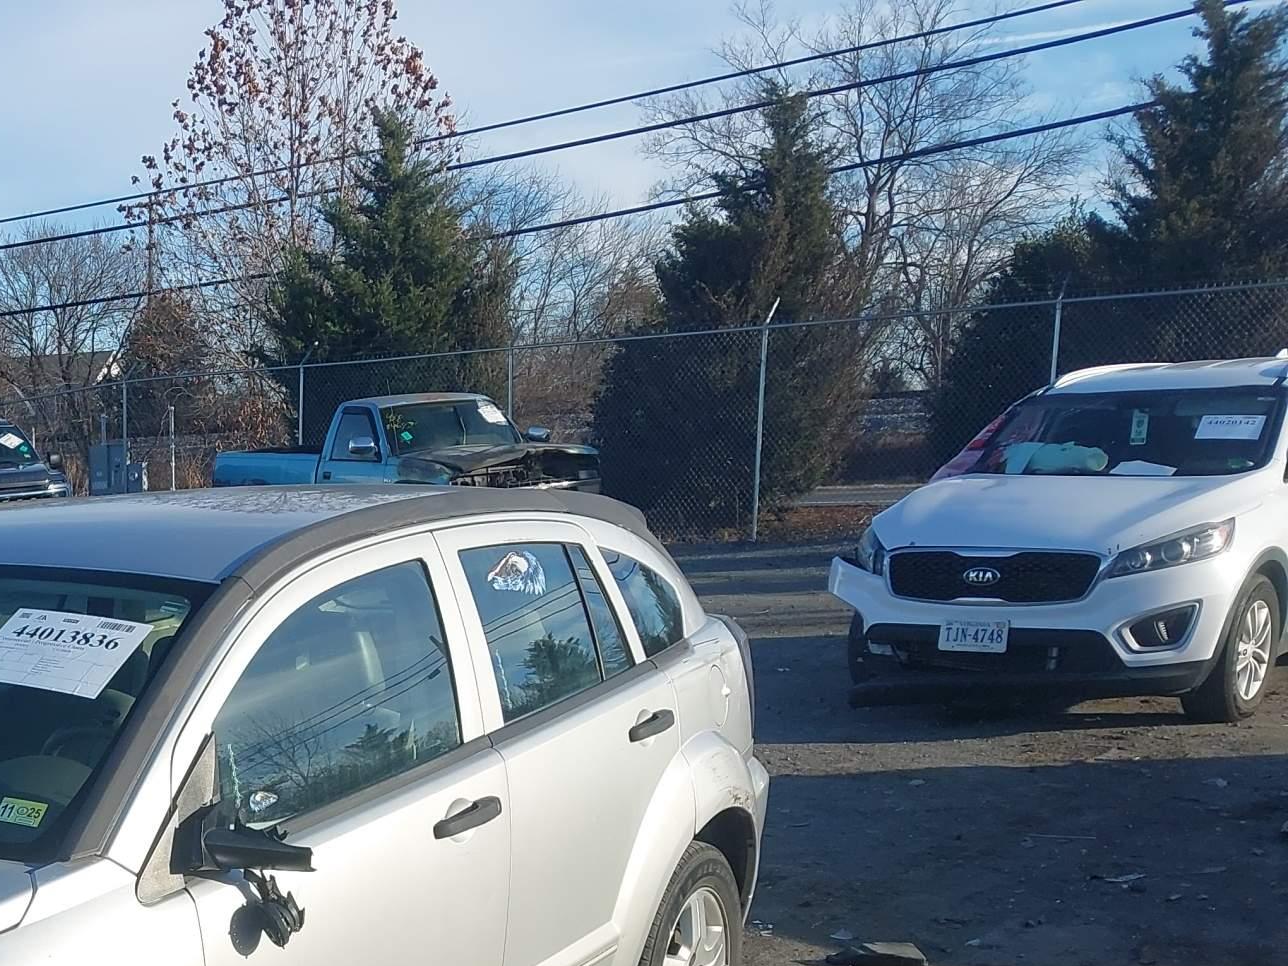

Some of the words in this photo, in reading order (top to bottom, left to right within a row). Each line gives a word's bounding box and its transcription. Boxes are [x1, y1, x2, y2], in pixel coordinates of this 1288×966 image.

[968, 571, 993, 582] KIA
[12, 624, 120, 650] 44013836
[945, 627, 1004, 644] TJN-4748
[0, 803, 15, 818] 11
[27, 807, 42, 819] 25
